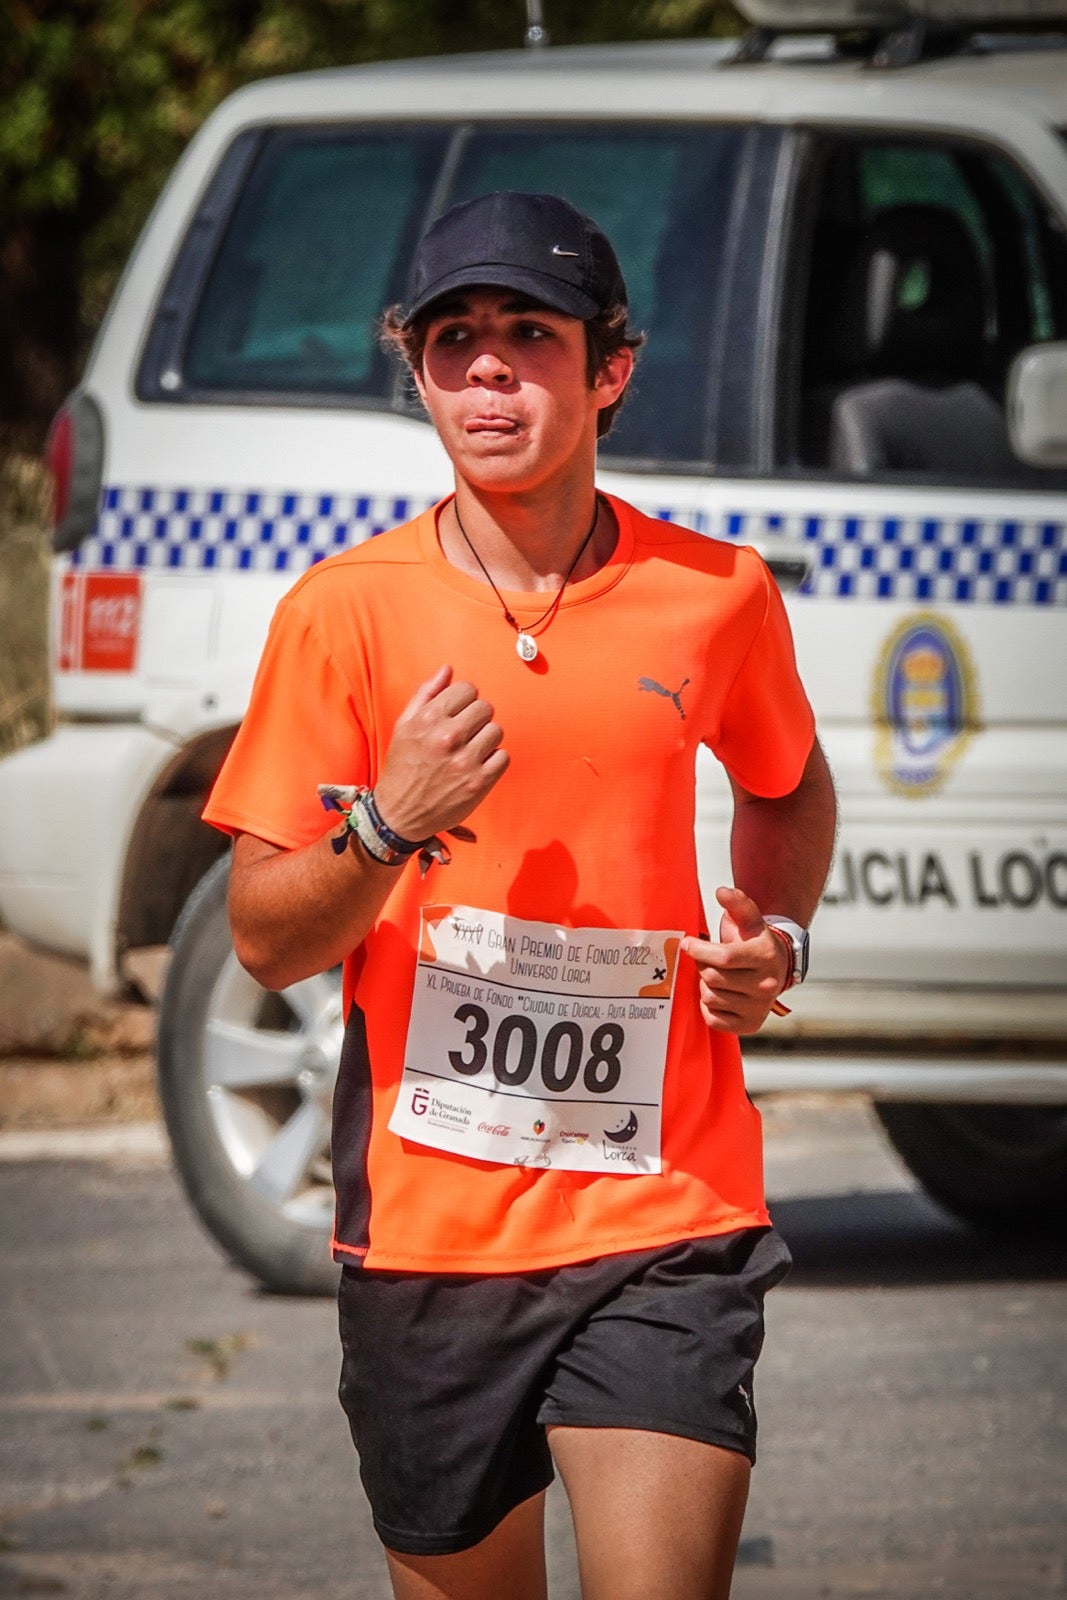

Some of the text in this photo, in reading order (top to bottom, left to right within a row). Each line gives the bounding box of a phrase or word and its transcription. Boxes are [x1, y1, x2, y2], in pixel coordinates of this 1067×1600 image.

[487, 929, 517, 954] GRAN
[520, 935, 563, 961] PREMIO
[567, 945, 583, 963] DE
[585, 944, 620, 966] FONDO
[622, 945, 651, 966] 2022
[510, 957, 591, 984] UNIVERSO LORCA
[426, 973, 437, 990] XL
[440, 976, 471, 998] PRUEBA
[473, 987, 485, 1002] DE
[486, 988, 514, 1009] FONDO
[517, 994, 555, 1015] "CIUDAD
[557, 1004, 570, 1018] DE
[607, 1003, 626, 1019] RUTA
[447, 1002, 625, 1094] 3008
[428, 1107, 471, 1126] de Granada
[430, 1097, 473, 1117] Diputación
[602, 1139, 637, 1162] Lorca
